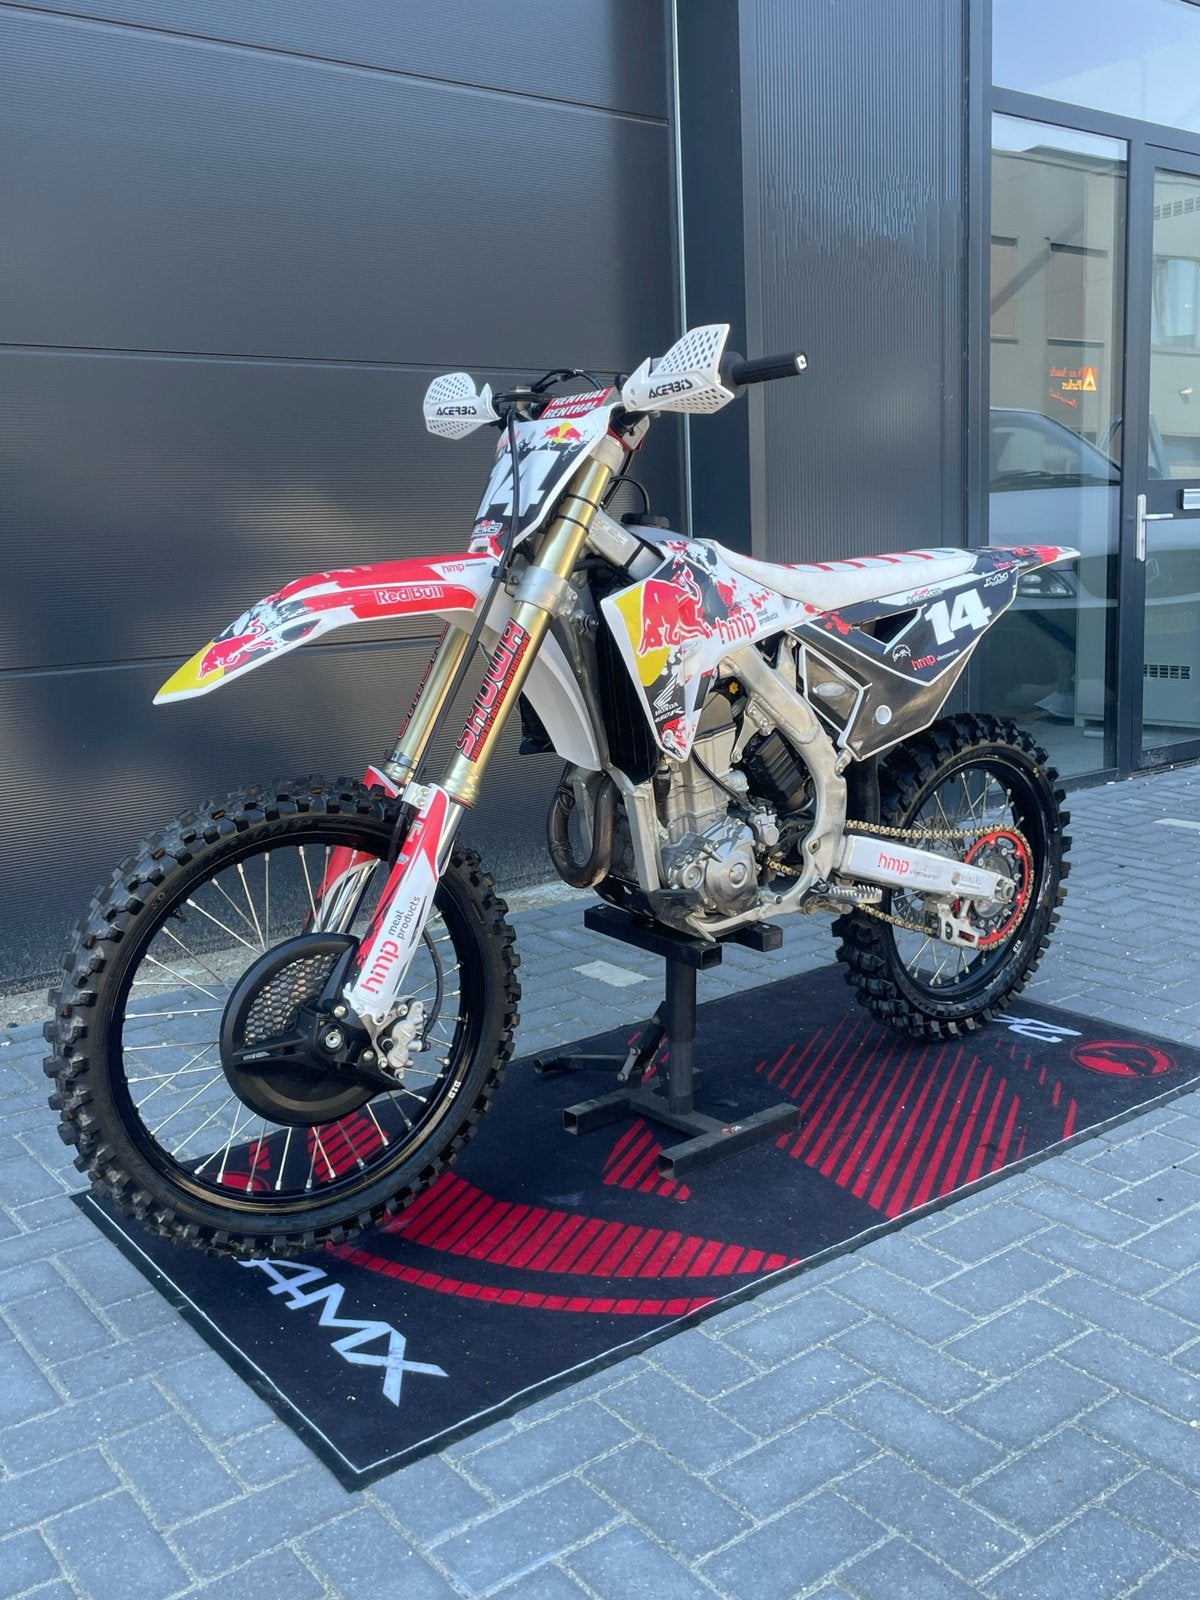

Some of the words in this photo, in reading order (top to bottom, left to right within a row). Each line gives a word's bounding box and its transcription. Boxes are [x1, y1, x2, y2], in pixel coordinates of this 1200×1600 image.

[551, 388, 608, 406] RENTHAL
[649, 378, 693, 399] ACERBIS
[436, 405, 477, 416] ACERBIS
[543, 400, 598, 419] RENTHAL
[441, 562, 465, 574] hmp
[374, 588, 410, 605] Red
[411, 586, 444, 600] Bull
[924, 588, 992, 645] 14
[715, 612, 757, 645] hmp
[503, 633, 531, 688] MOTORSPORT
[911, 655, 936, 671] hmp
[456, 617, 526, 760] SHOWA
[655, 702, 679, 716] HONDA
[878, 852, 910, 875] hmp
[388, 909, 405, 936] meat
[397, 895, 421, 940] products
[360, 940, 399, 994] hmp
[448, 1080, 461, 1099] DID
